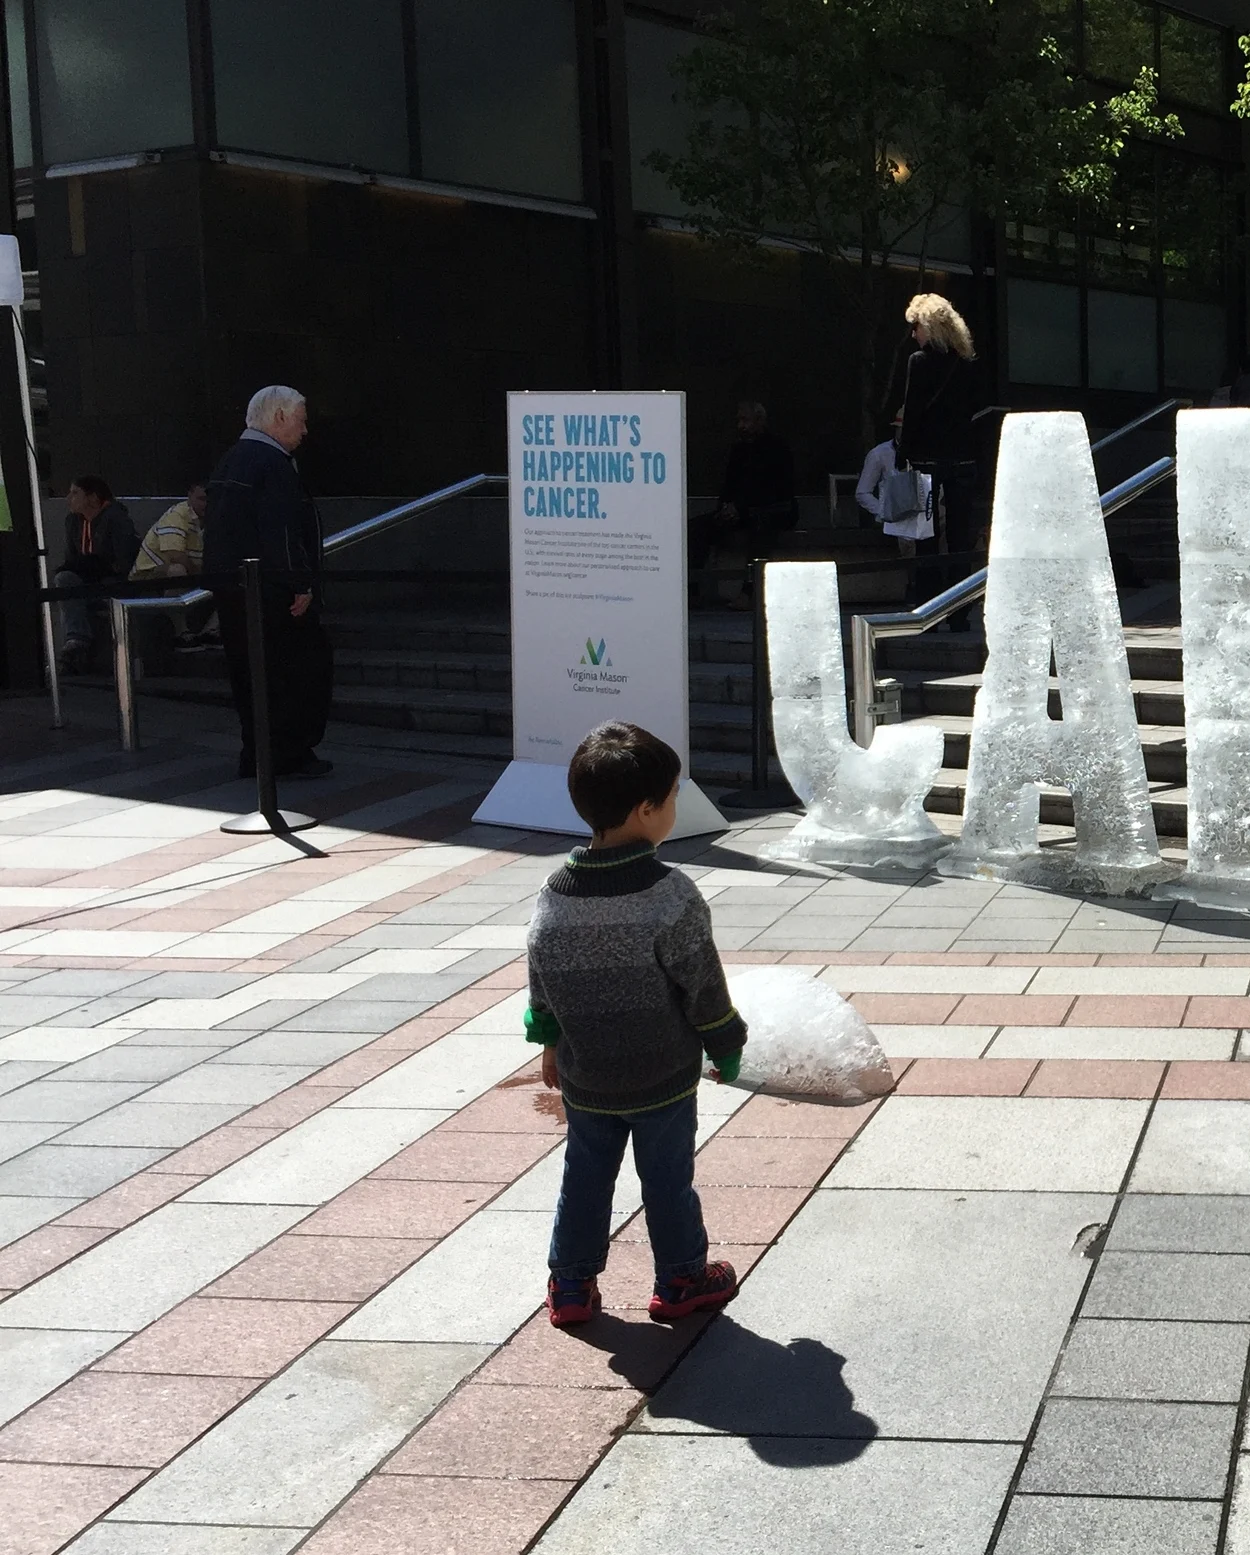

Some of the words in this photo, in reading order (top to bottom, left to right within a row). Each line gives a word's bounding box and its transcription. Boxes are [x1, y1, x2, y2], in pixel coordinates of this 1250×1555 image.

[522, 414, 555, 446] SEE
[563, 414, 641, 447] WHAT'S
[523, 450, 635, 484] HAPPENING
[640, 451, 666, 484] TO
[524, 486, 608, 519] CANCER.
[566, 668, 598, 682] Virginia
[600, 671, 628, 683] Mason
[573, 683, 595, 693] Cancer
[595, 685, 621, 695] Institute
